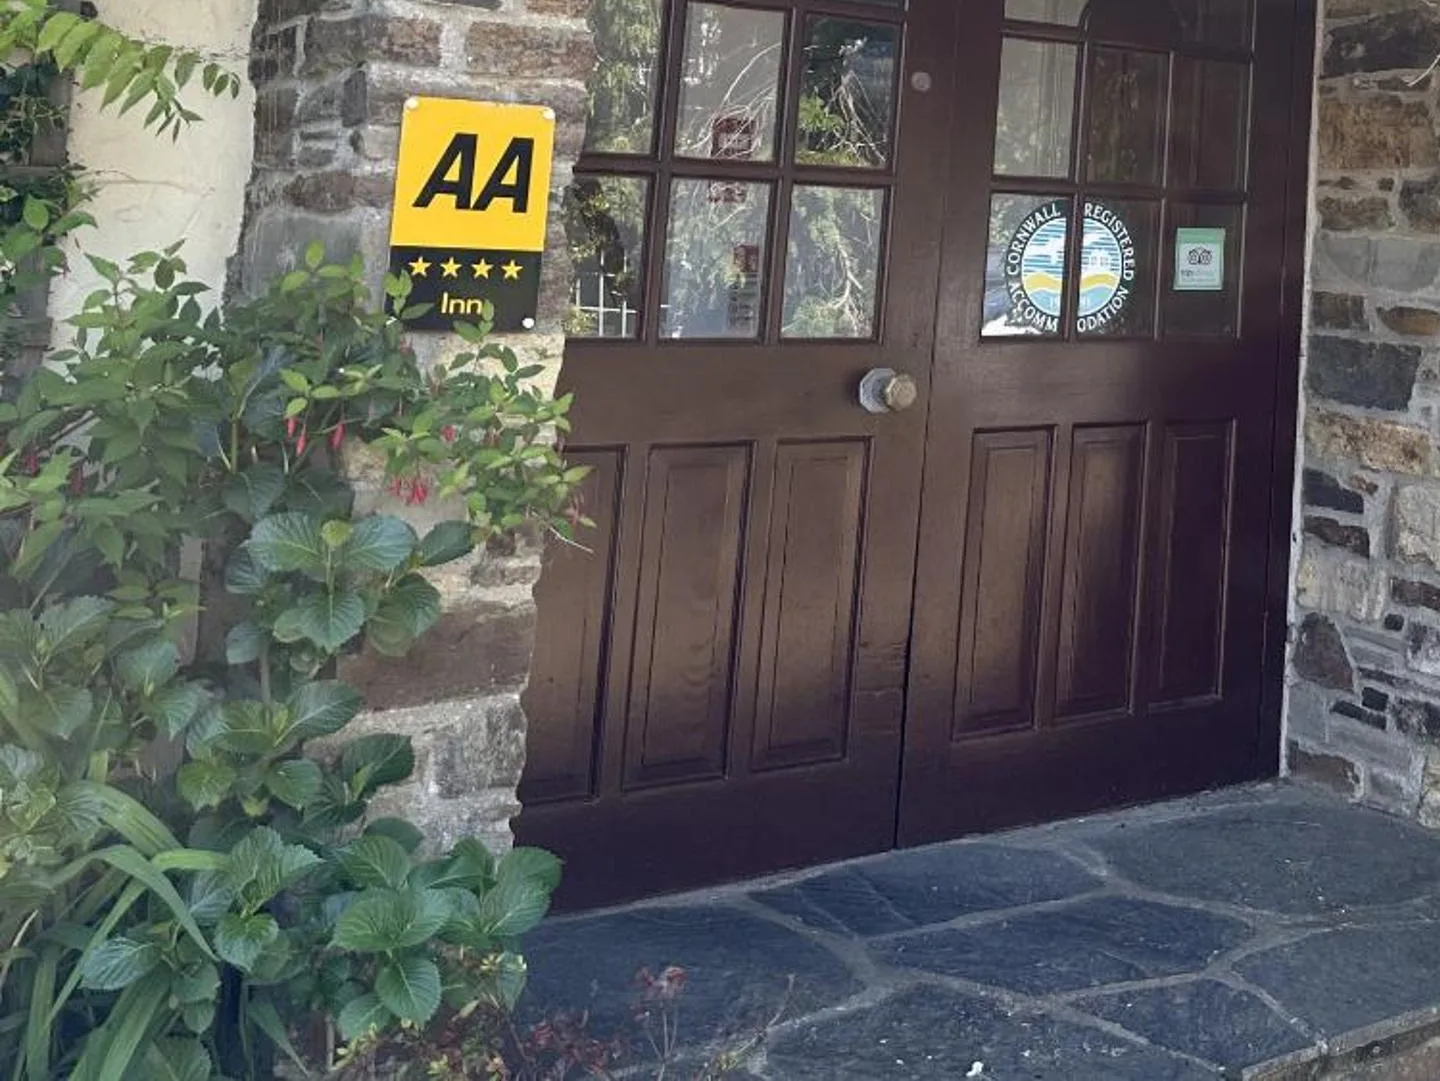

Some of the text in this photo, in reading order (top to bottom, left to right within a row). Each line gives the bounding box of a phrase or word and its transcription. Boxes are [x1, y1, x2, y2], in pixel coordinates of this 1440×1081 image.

[412, 132, 535, 214] AA
[1007, 203, 1135, 281] CORNWALL REGISTERED
[440, 292, 483, 315] Inn
